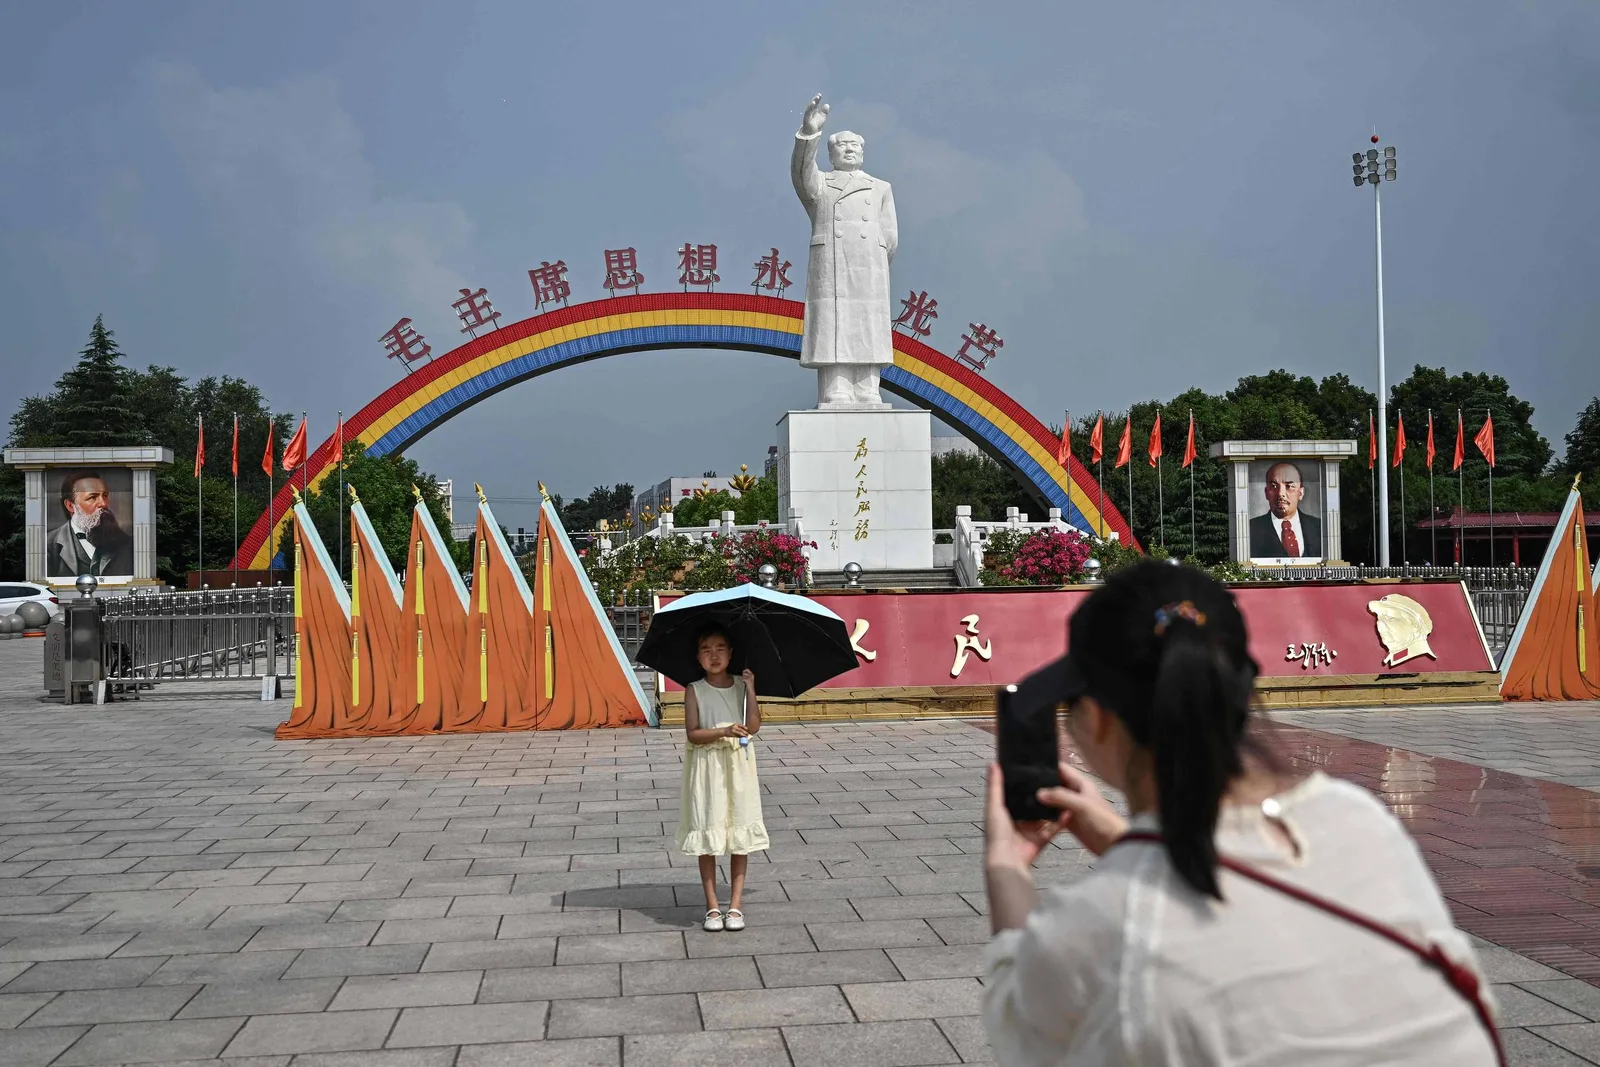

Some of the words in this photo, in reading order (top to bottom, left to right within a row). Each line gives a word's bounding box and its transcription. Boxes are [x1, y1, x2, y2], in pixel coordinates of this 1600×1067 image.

[377, 243, 1003, 370] 毛主席思想永光芒
